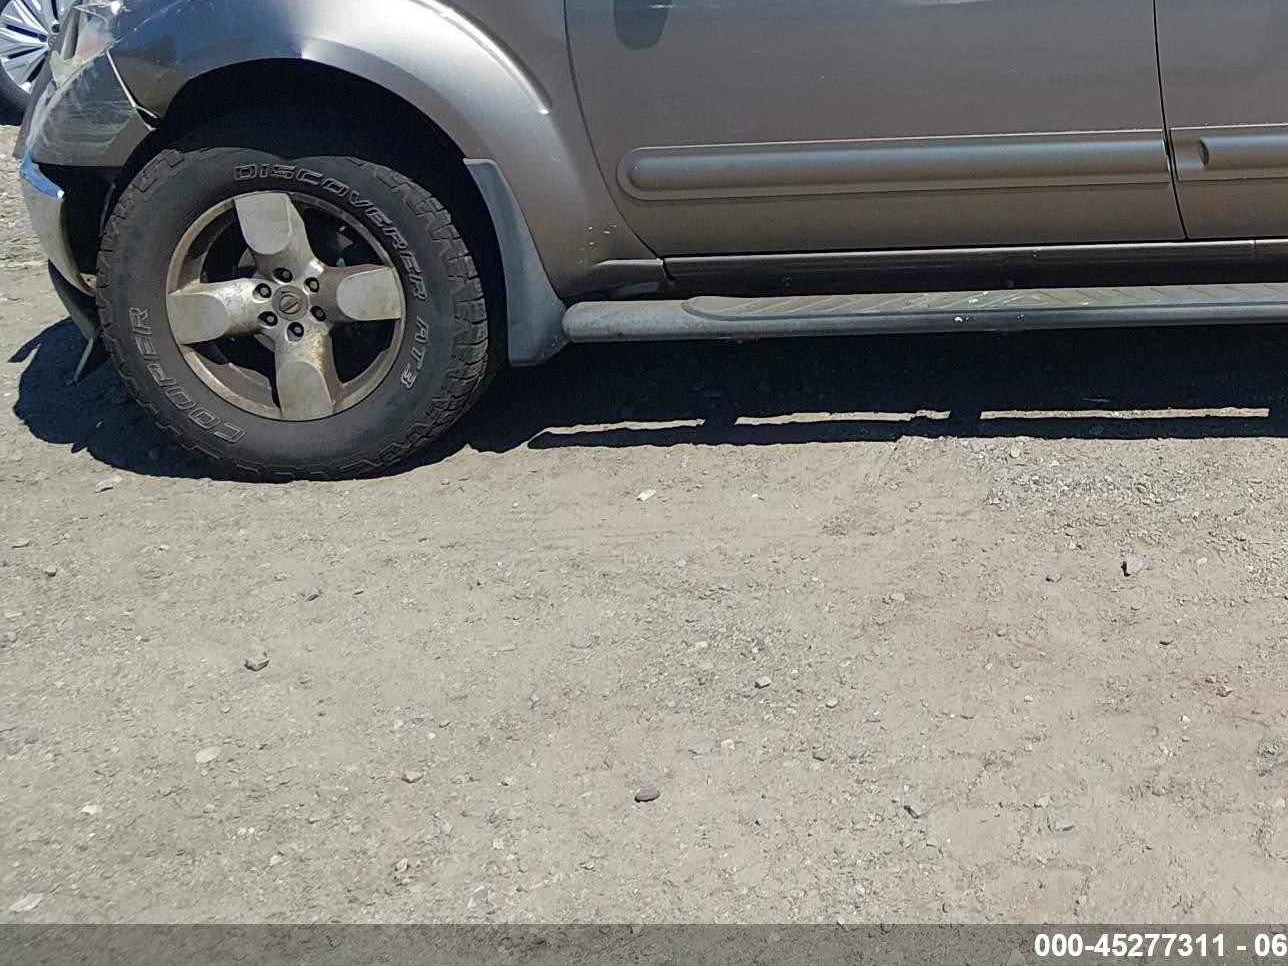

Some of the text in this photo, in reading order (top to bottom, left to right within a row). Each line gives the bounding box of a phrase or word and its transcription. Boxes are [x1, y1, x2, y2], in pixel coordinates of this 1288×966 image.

[233, 162, 432, 392] DISCOVERER AT3
[129, 306, 248, 444] COOPER
